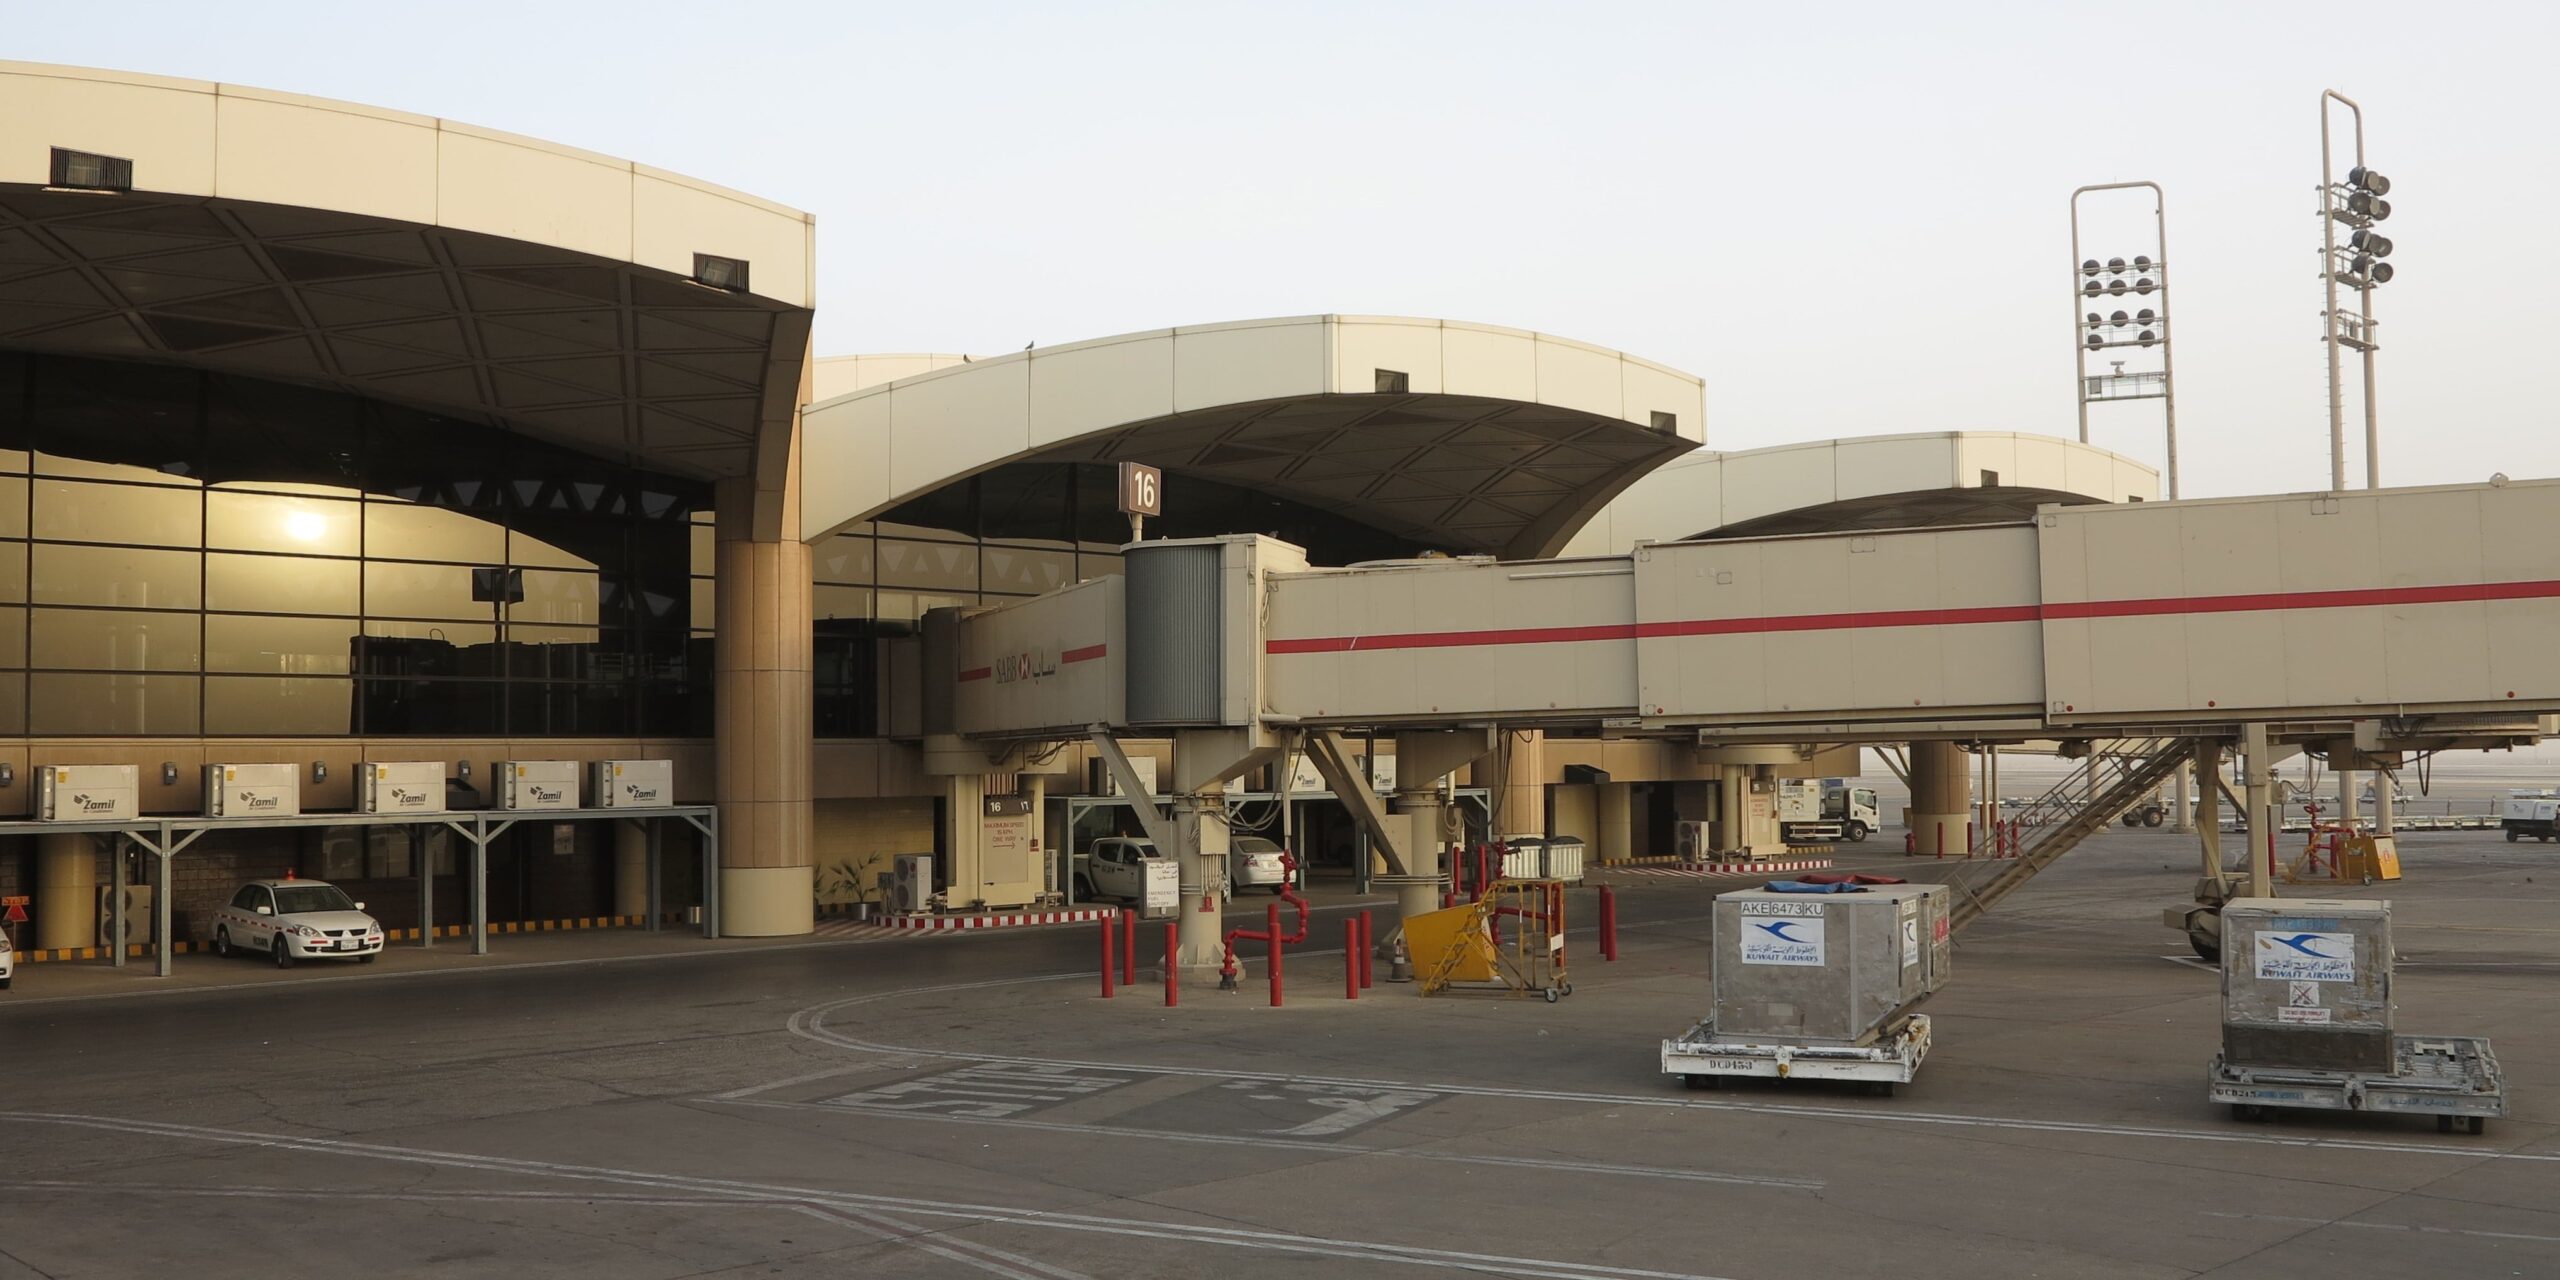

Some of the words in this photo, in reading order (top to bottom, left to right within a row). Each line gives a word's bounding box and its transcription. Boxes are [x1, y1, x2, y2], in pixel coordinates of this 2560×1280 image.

[1134, 470, 1155, 508] 16
[996, 655, 1017, 685] SABB
[399, 793, 427, 803] Zamil
[537, 791, 562, 801] Zamil
[634, 789, 657, 799] Zamil
[83, 799, 116, 810] Zamil
[248, 796, 279, 807] Zamil
[990, 801, 1001, 813] 16
[1742, 903, 1769, 914] AKE
[1772, 903, 1803, 914] 6473
[1805, 904, 1824, 914] KU
[1746, 953, 1781, 961] KUWAIT
[1782, 954, 1819, 962] AIRWAYS
[2261, 968, 2302, 979] KUWAIT
[2305, 970, 2352, 981] AIRWAYS
